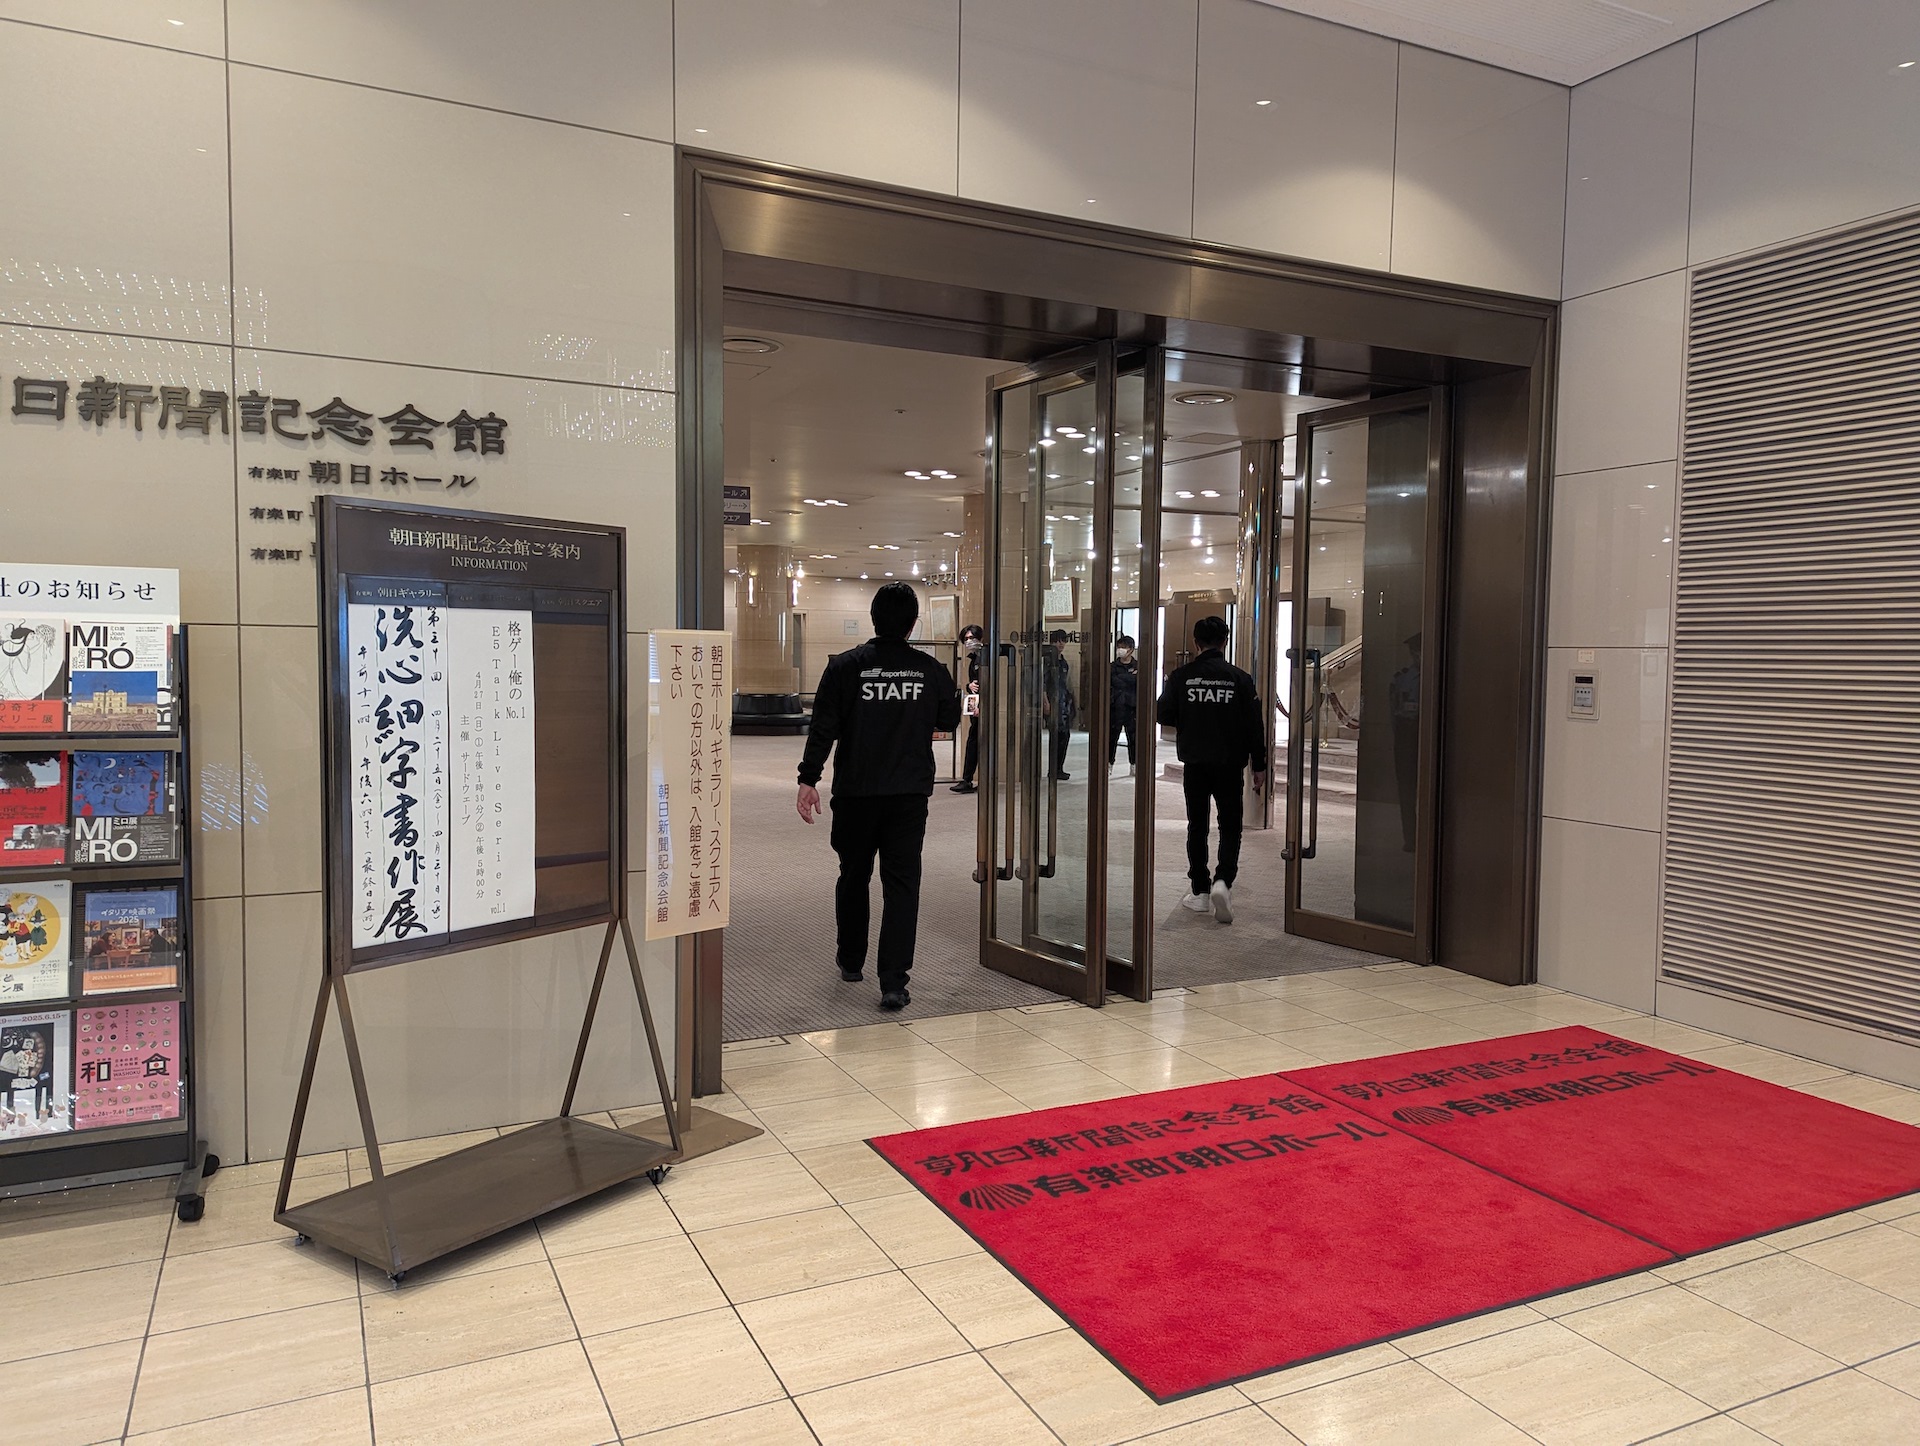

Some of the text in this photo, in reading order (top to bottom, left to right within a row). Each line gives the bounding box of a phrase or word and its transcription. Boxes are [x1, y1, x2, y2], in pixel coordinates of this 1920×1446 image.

[248, 460, 477, 490] 有楽町 朝日ホール
[250, 506, 304, 522] 有楽町
[250, 547, 303, 562] 有楽町
[389, 528, 581, 561] 朝日新聞記念会館ご案内
[451, 556, 529, 572] INFORMATION
[377, 586, 442, 599] 朝日ギャラリー
[73, 625, 108, 647] MI
[86, 642, 134, 670] RÓ
[670, 645, 683, 699] 下さい
[492, 659, 501, 719] Talk
[861, 682, 924, 700] STAFF
[1187, 688, 1235, 703] STAFF
[460, 715, 470, 742] 主催
[372, 606, 429, 939] 洗心細字書作展
[493, 731, 502, 791] Live
[688, 645, 704, 918] おいでの方以外は、入館をご遠慮
[74, 817, 112, 841] MI
[88, 832, 138, 863] RÓ
[494, 802, 503, 897] Series
[657, 784, 669, 923] 朝日新聞記念会館
[101, 907, 156, 917] イタリア映画祭
[118, 916, 140, 925] 2025
[1333, 1040, 1652, 1101] 朝日新聞記念会館
[1439, 1060, 1717, 1117] 有楽町朝日ホール
[914, 1093, 1331, 1177] 朝日新聞記念会館
[1028, 1121, 1390, 1198] 有楽町朝日ホール
